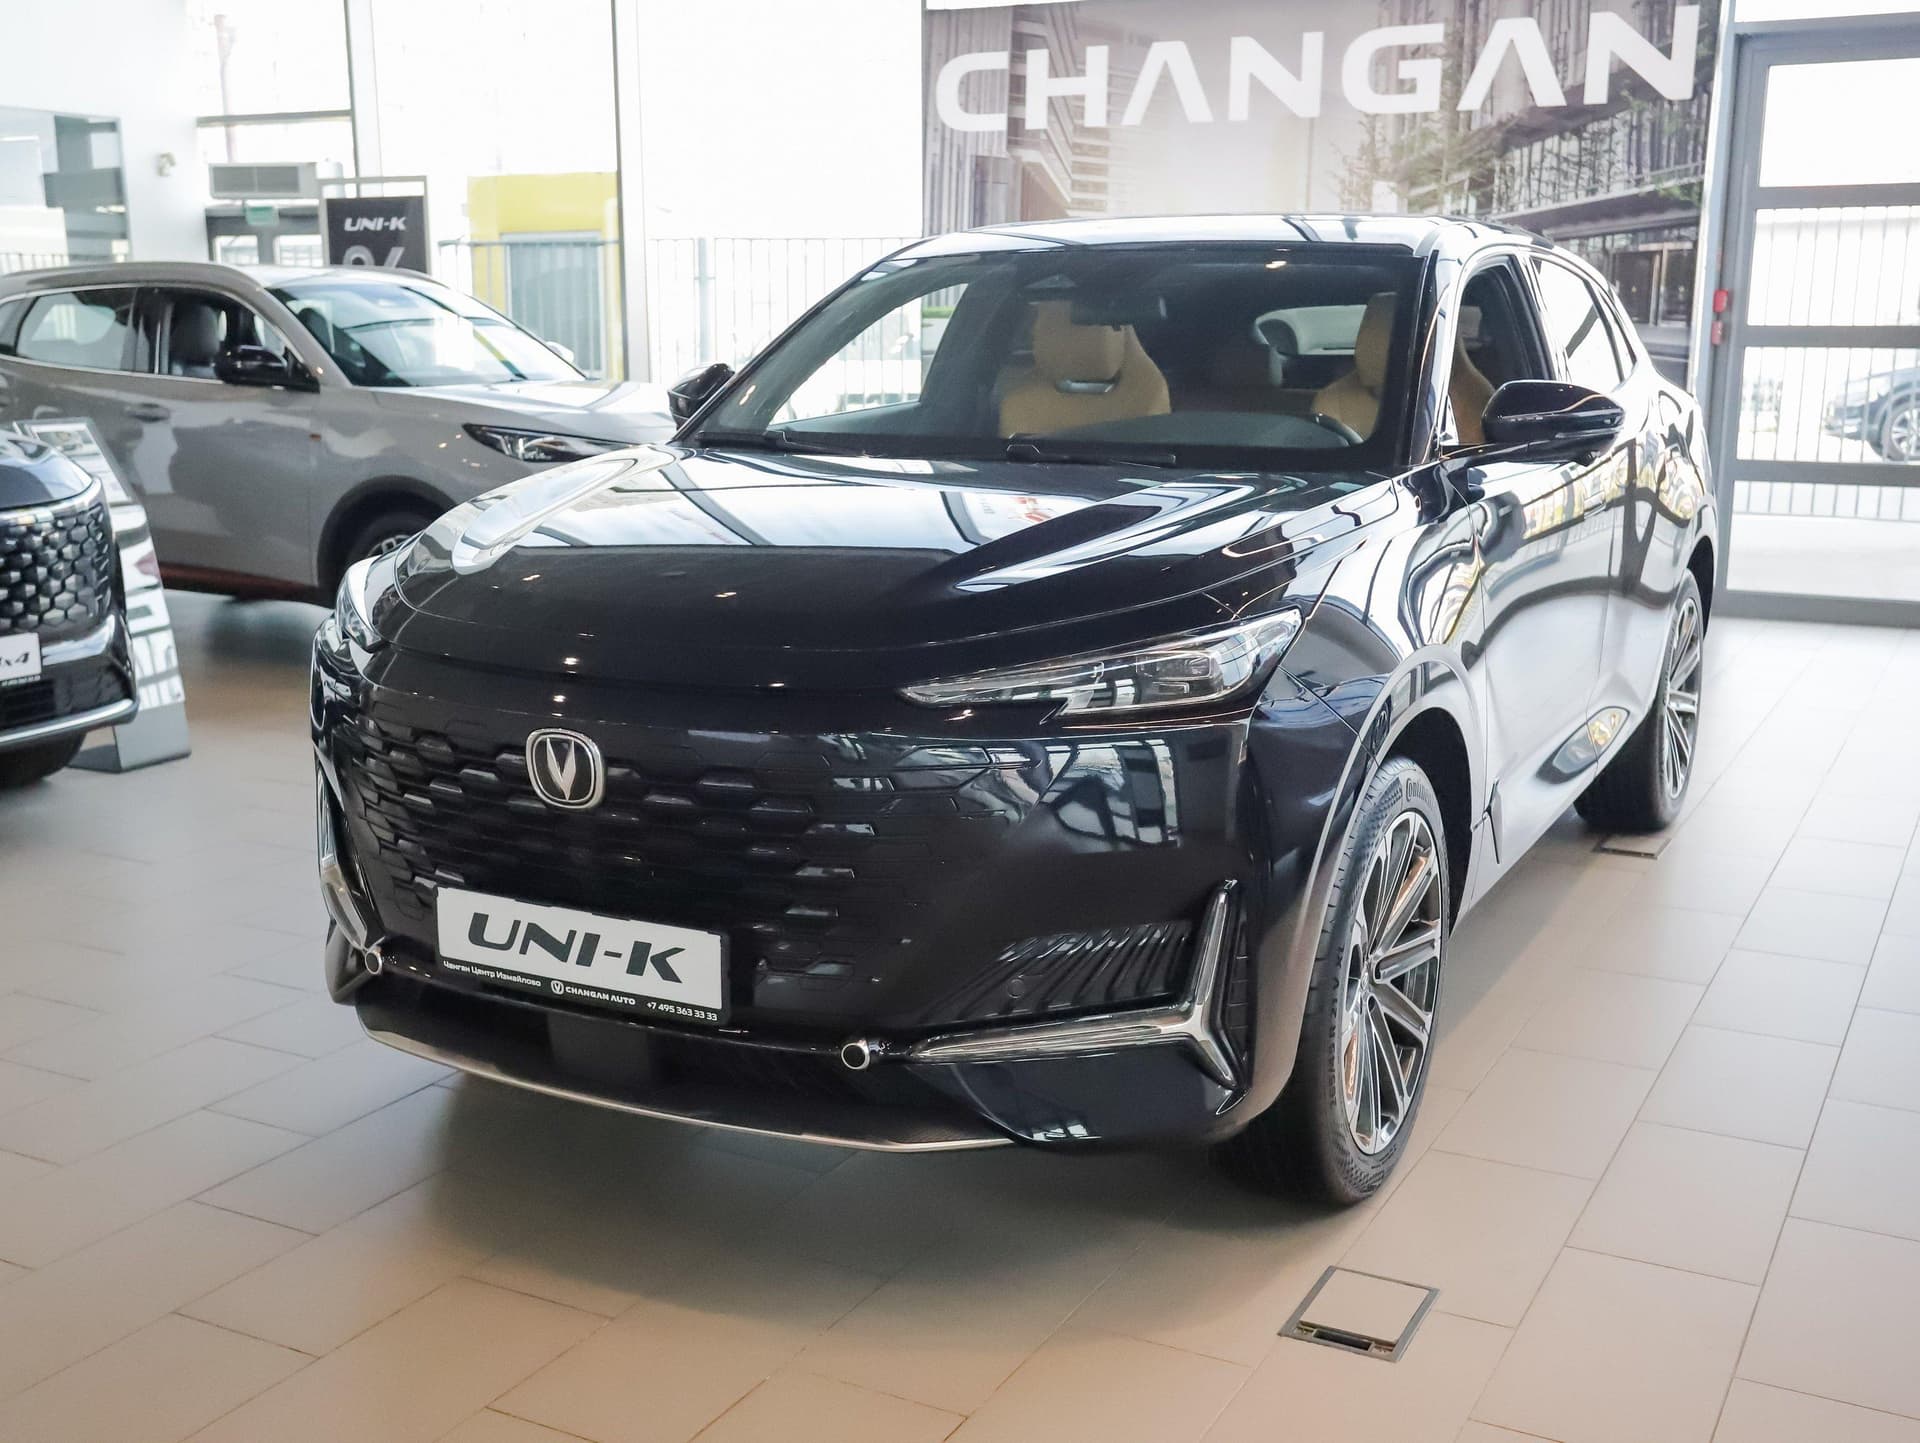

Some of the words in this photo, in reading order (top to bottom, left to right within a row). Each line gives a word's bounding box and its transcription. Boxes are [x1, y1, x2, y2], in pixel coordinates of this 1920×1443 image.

[936, 5, 1700, 132] CHANGAN
[343, 216, 407, 232] UNI-K
[468, 912, 686, 984] UNI-K
[471, 966, 496, 978] Центр
[496, 971, 542, 987] Измайлово
[565, 986, 609, 1001] CHANGAN
[610, 995, 636, 1006] AUTO
[647, 1002, 657, 1010] +7
[658, 1003, 676, 1013] 495
[676, 1007, 693, 1016] 363
[693, 1010, 705, 1019] 33
[706, 1012, 718, 1021] 33
